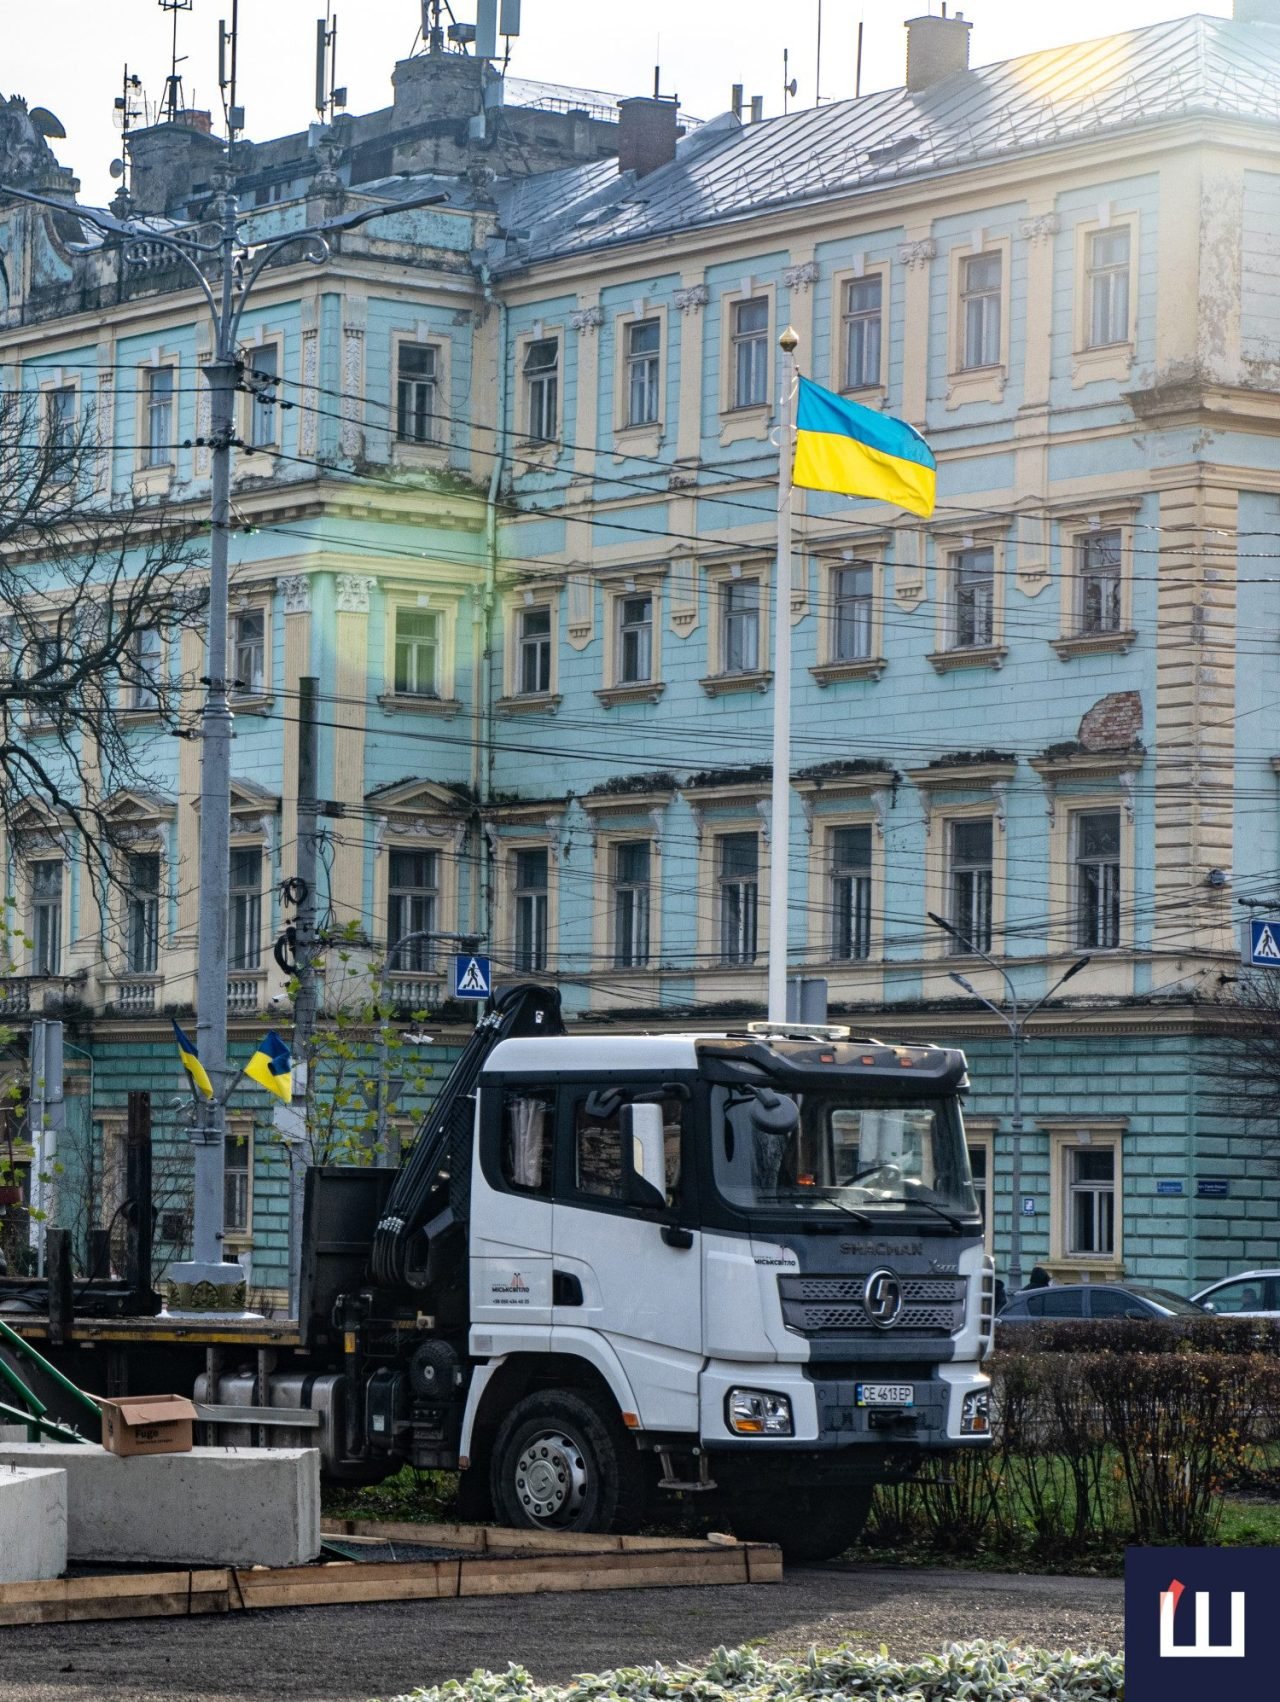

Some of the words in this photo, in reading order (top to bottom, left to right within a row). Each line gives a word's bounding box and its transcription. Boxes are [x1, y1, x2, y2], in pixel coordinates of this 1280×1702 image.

[840, 1242, 923, 1255] SHACMAN
[864, 1386, 876, 1400] CE
[878, 1387, 897, 1400] 4613
[899, 1388, 911, 1401] EP
